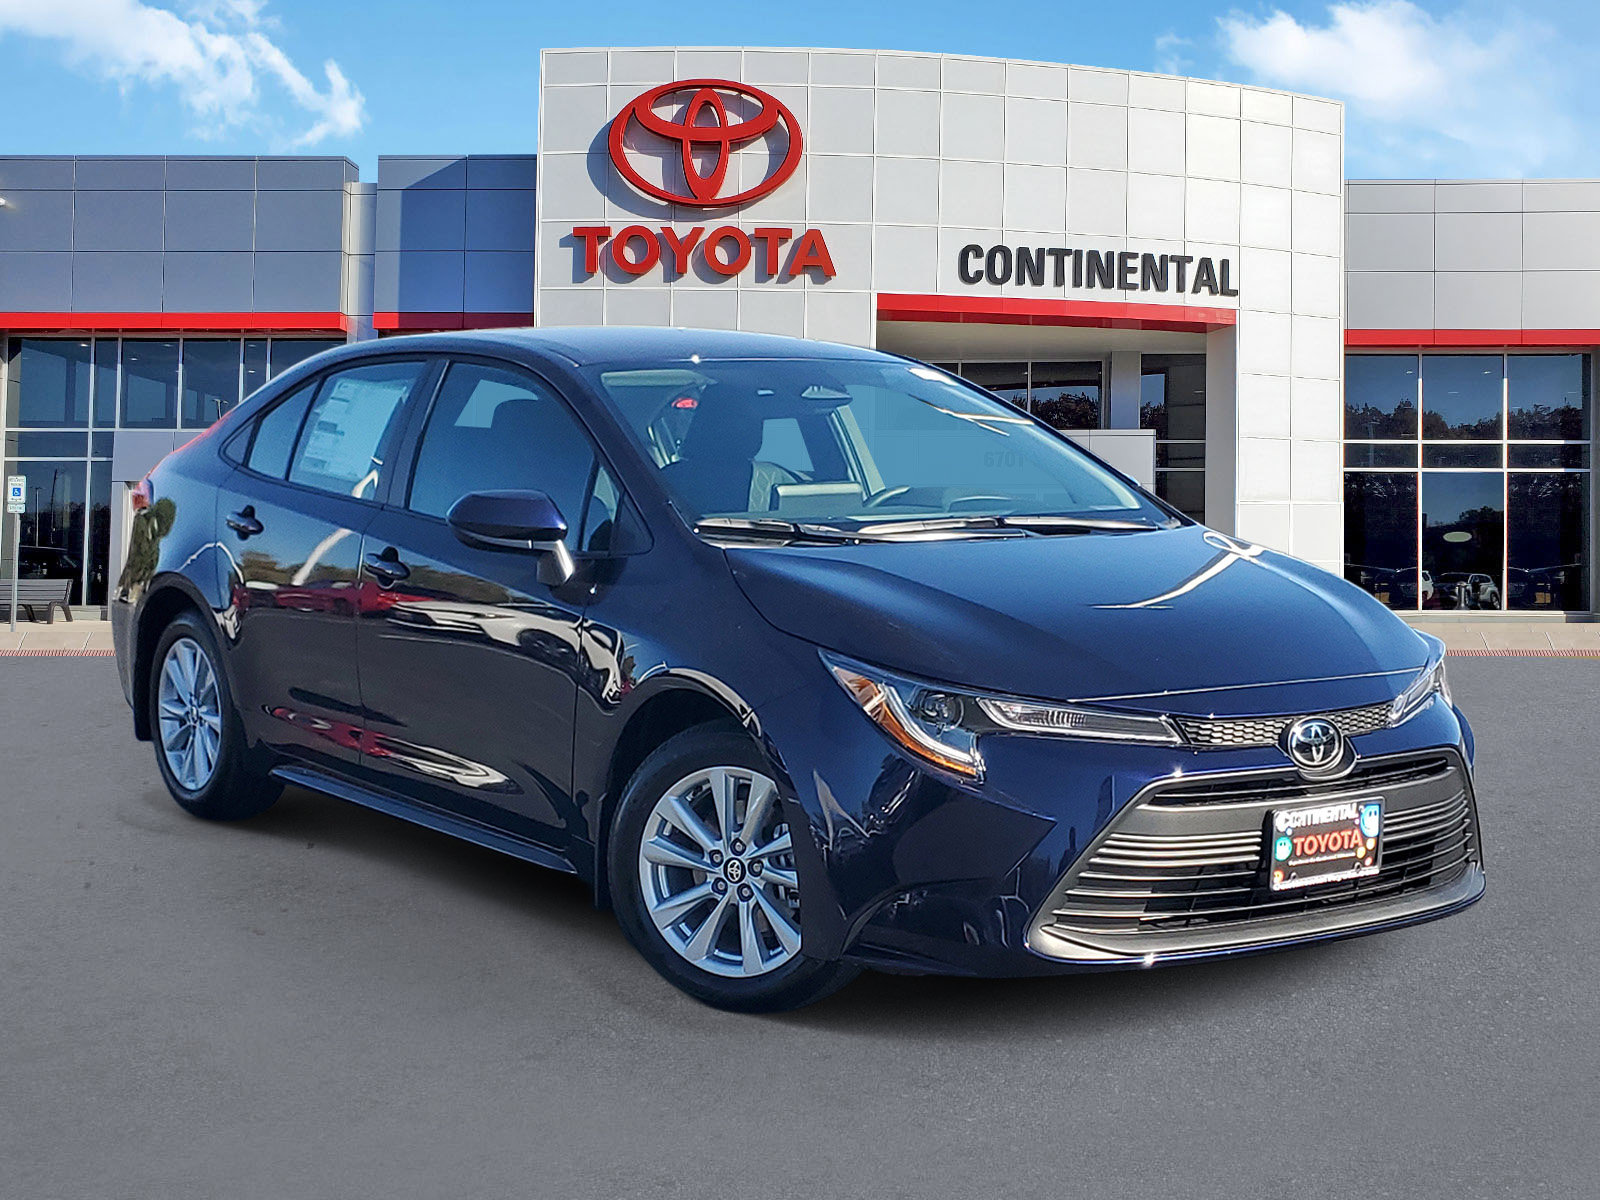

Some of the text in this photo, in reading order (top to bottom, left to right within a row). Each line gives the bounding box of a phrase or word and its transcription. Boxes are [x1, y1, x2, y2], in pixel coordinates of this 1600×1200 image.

[572, 225, 837, 277] TOYOTA
[959, 244, 1239, 297] CONTINENTAL
[1293, 828, 1363, 856] TOYOTA
